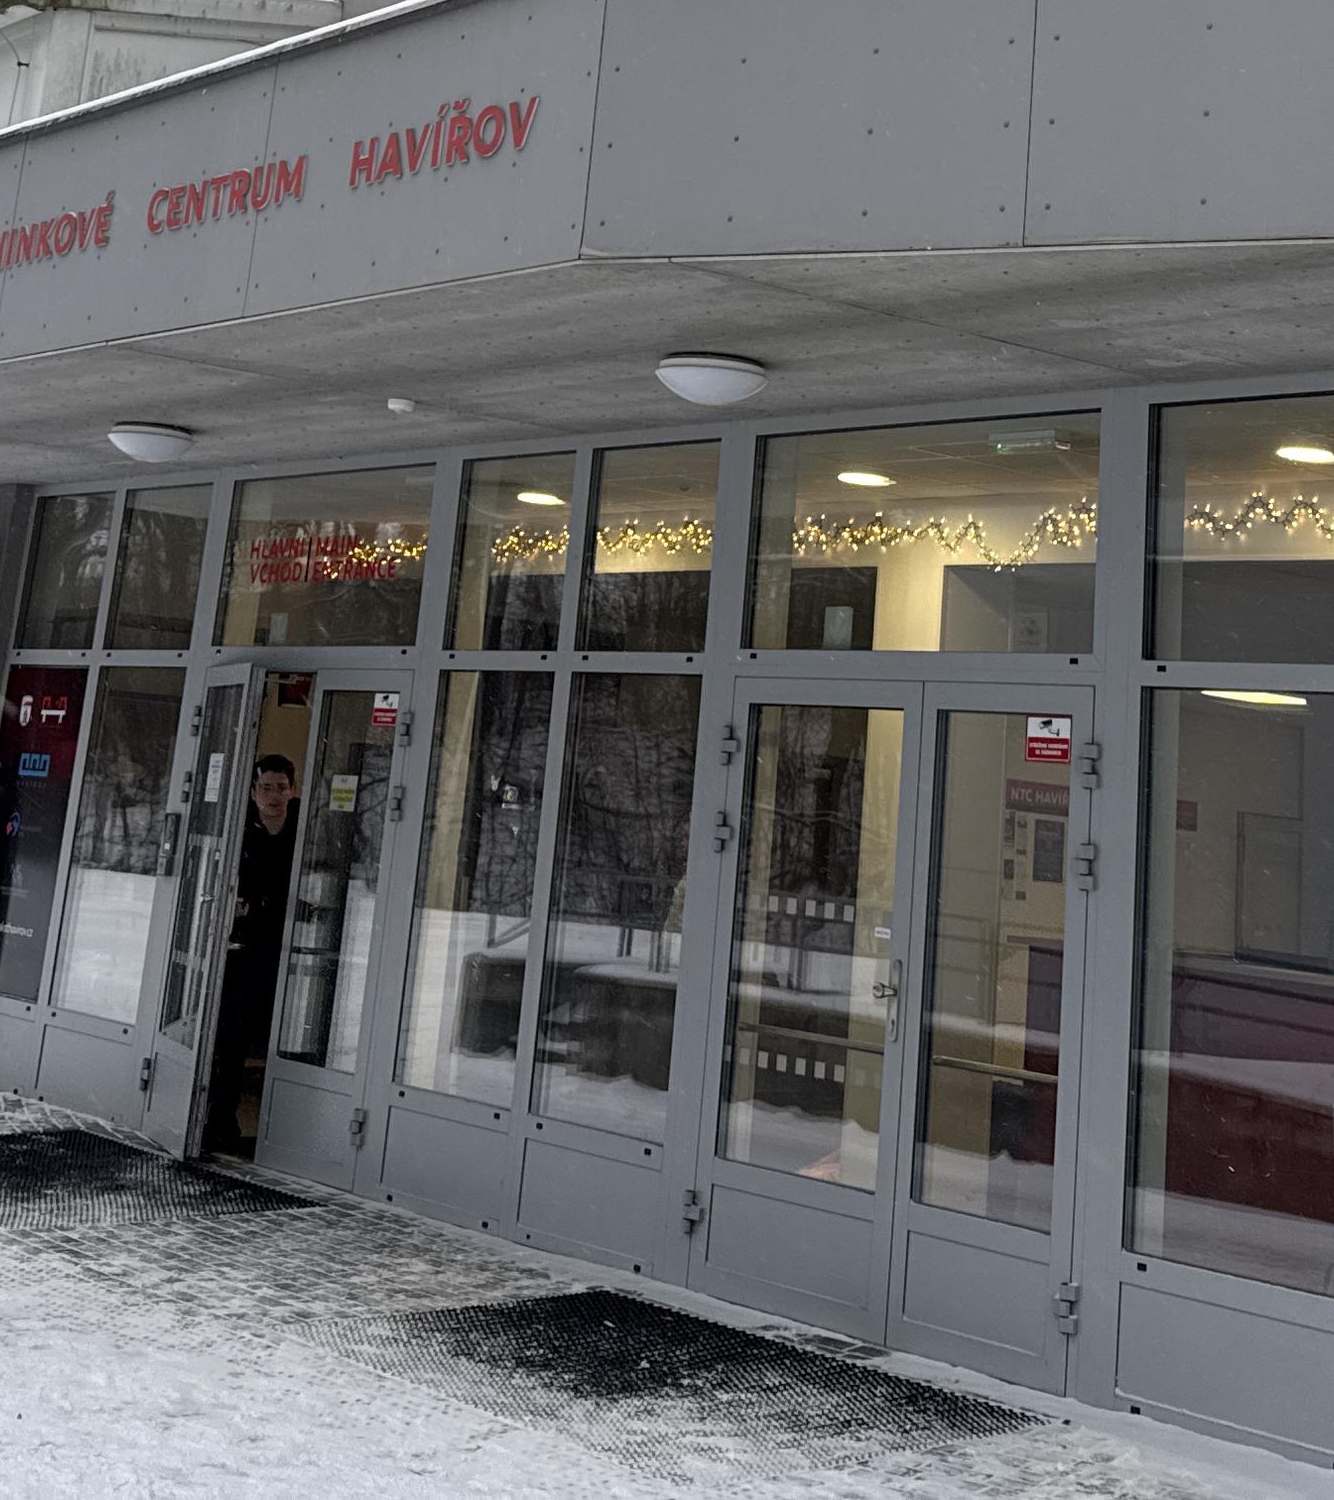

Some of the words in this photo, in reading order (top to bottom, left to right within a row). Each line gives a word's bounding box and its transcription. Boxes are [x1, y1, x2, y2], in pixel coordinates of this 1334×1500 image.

[146, 154, 307, 234] CENTRUM
[349, 96, 540, 189] HAVÍŘOV
[315, 534, 359, 558] MAIN
[250, 562, 302, 585] VCHOD
[312, 556, 396, 581] ENTRANCE
[1010, 787, 1033, 803] NTC
